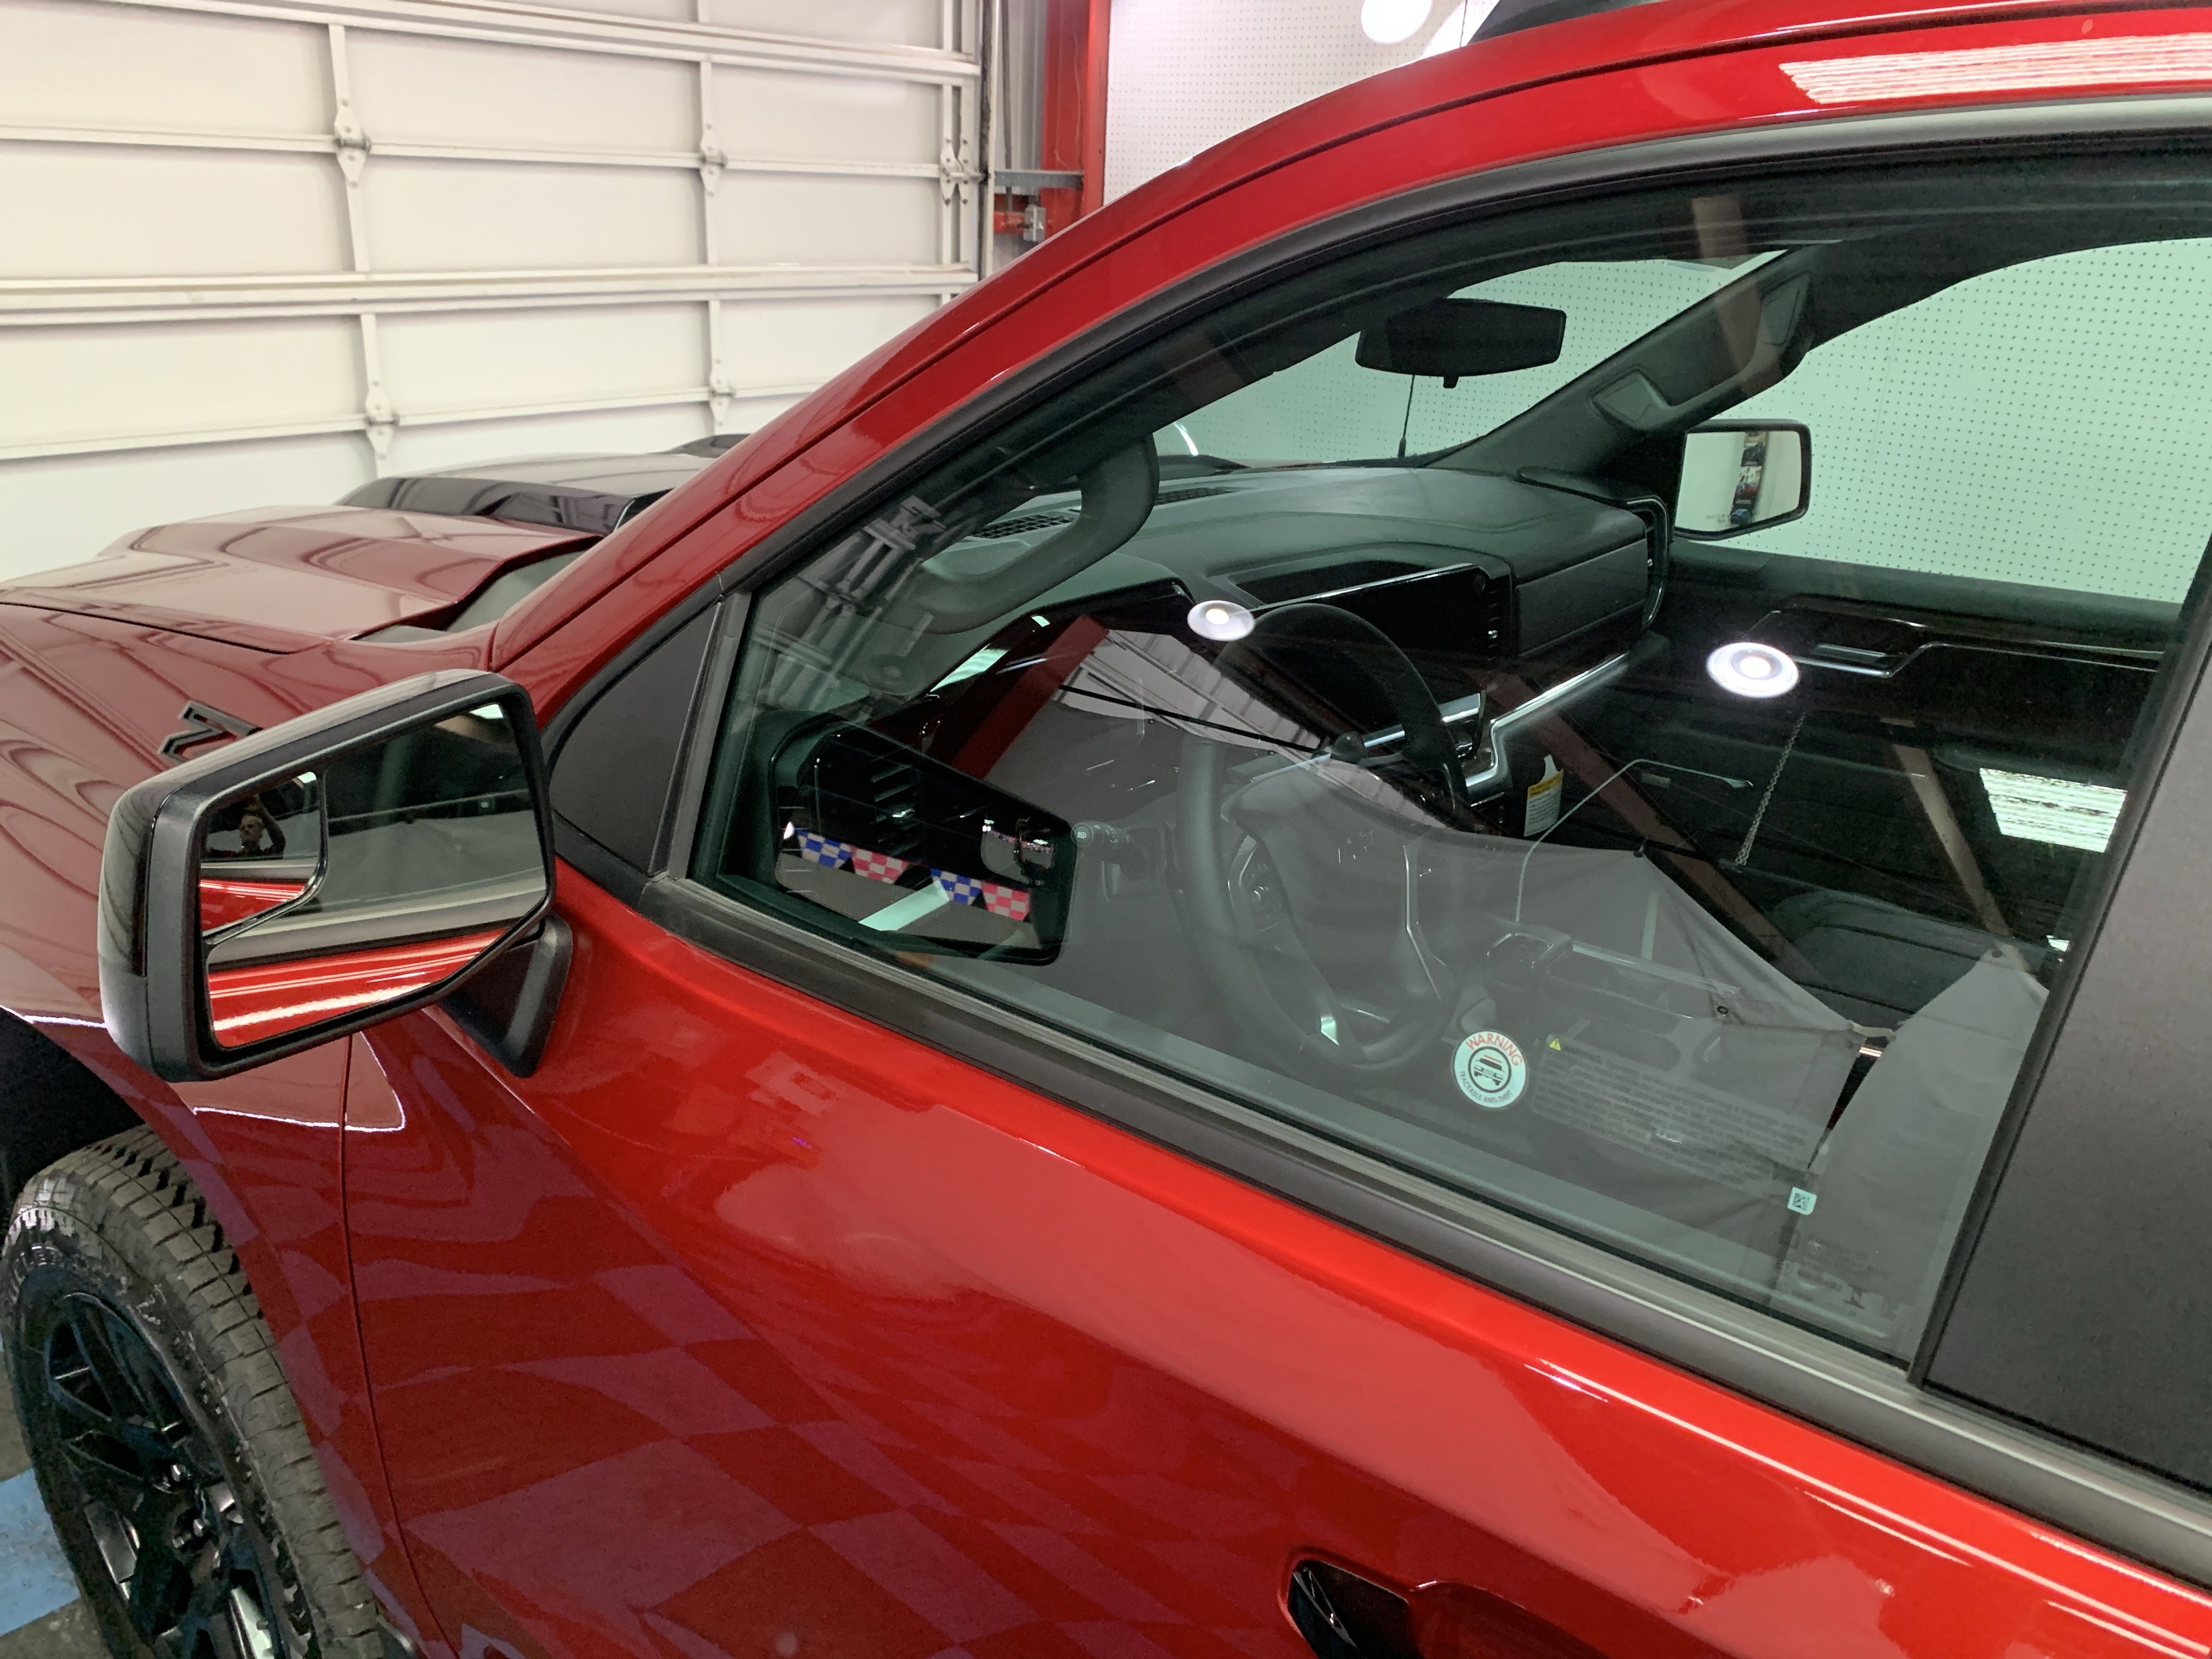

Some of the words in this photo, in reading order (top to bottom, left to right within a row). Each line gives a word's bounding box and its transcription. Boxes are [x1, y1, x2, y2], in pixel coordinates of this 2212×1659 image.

[1465, 1033, 1522, 1066] WARNING
[1459, 1071, 1482, 1101] TRACEABLE
[1483, 1090, 1514, 1104] ANTI-THEFT
